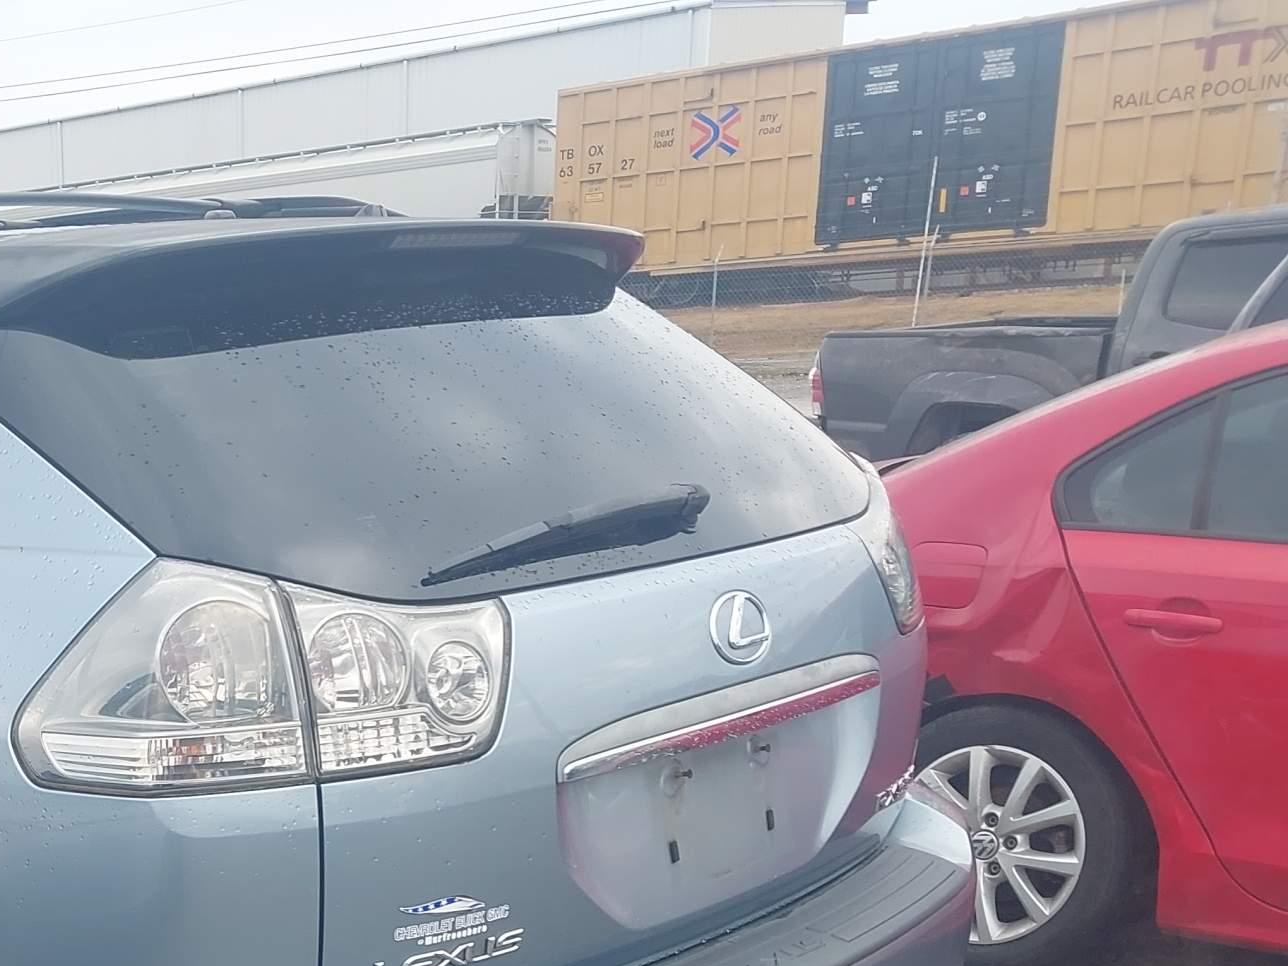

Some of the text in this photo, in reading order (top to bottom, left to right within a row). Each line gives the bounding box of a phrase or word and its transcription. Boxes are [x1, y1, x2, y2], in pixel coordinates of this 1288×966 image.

[1112, 85, 1196, 110] RAILCAR
[759, 111, 778, 124] any
[653, 127, 675, 138] next
[758, 124, 783, 136] road
[653, 138, 675, 149] load
[560, 144, 605, 161] TB OX
[559, 158, 636, 179] 63 57 27
[394, 904, 510, 941] CHEVROLET BUICK GMC
